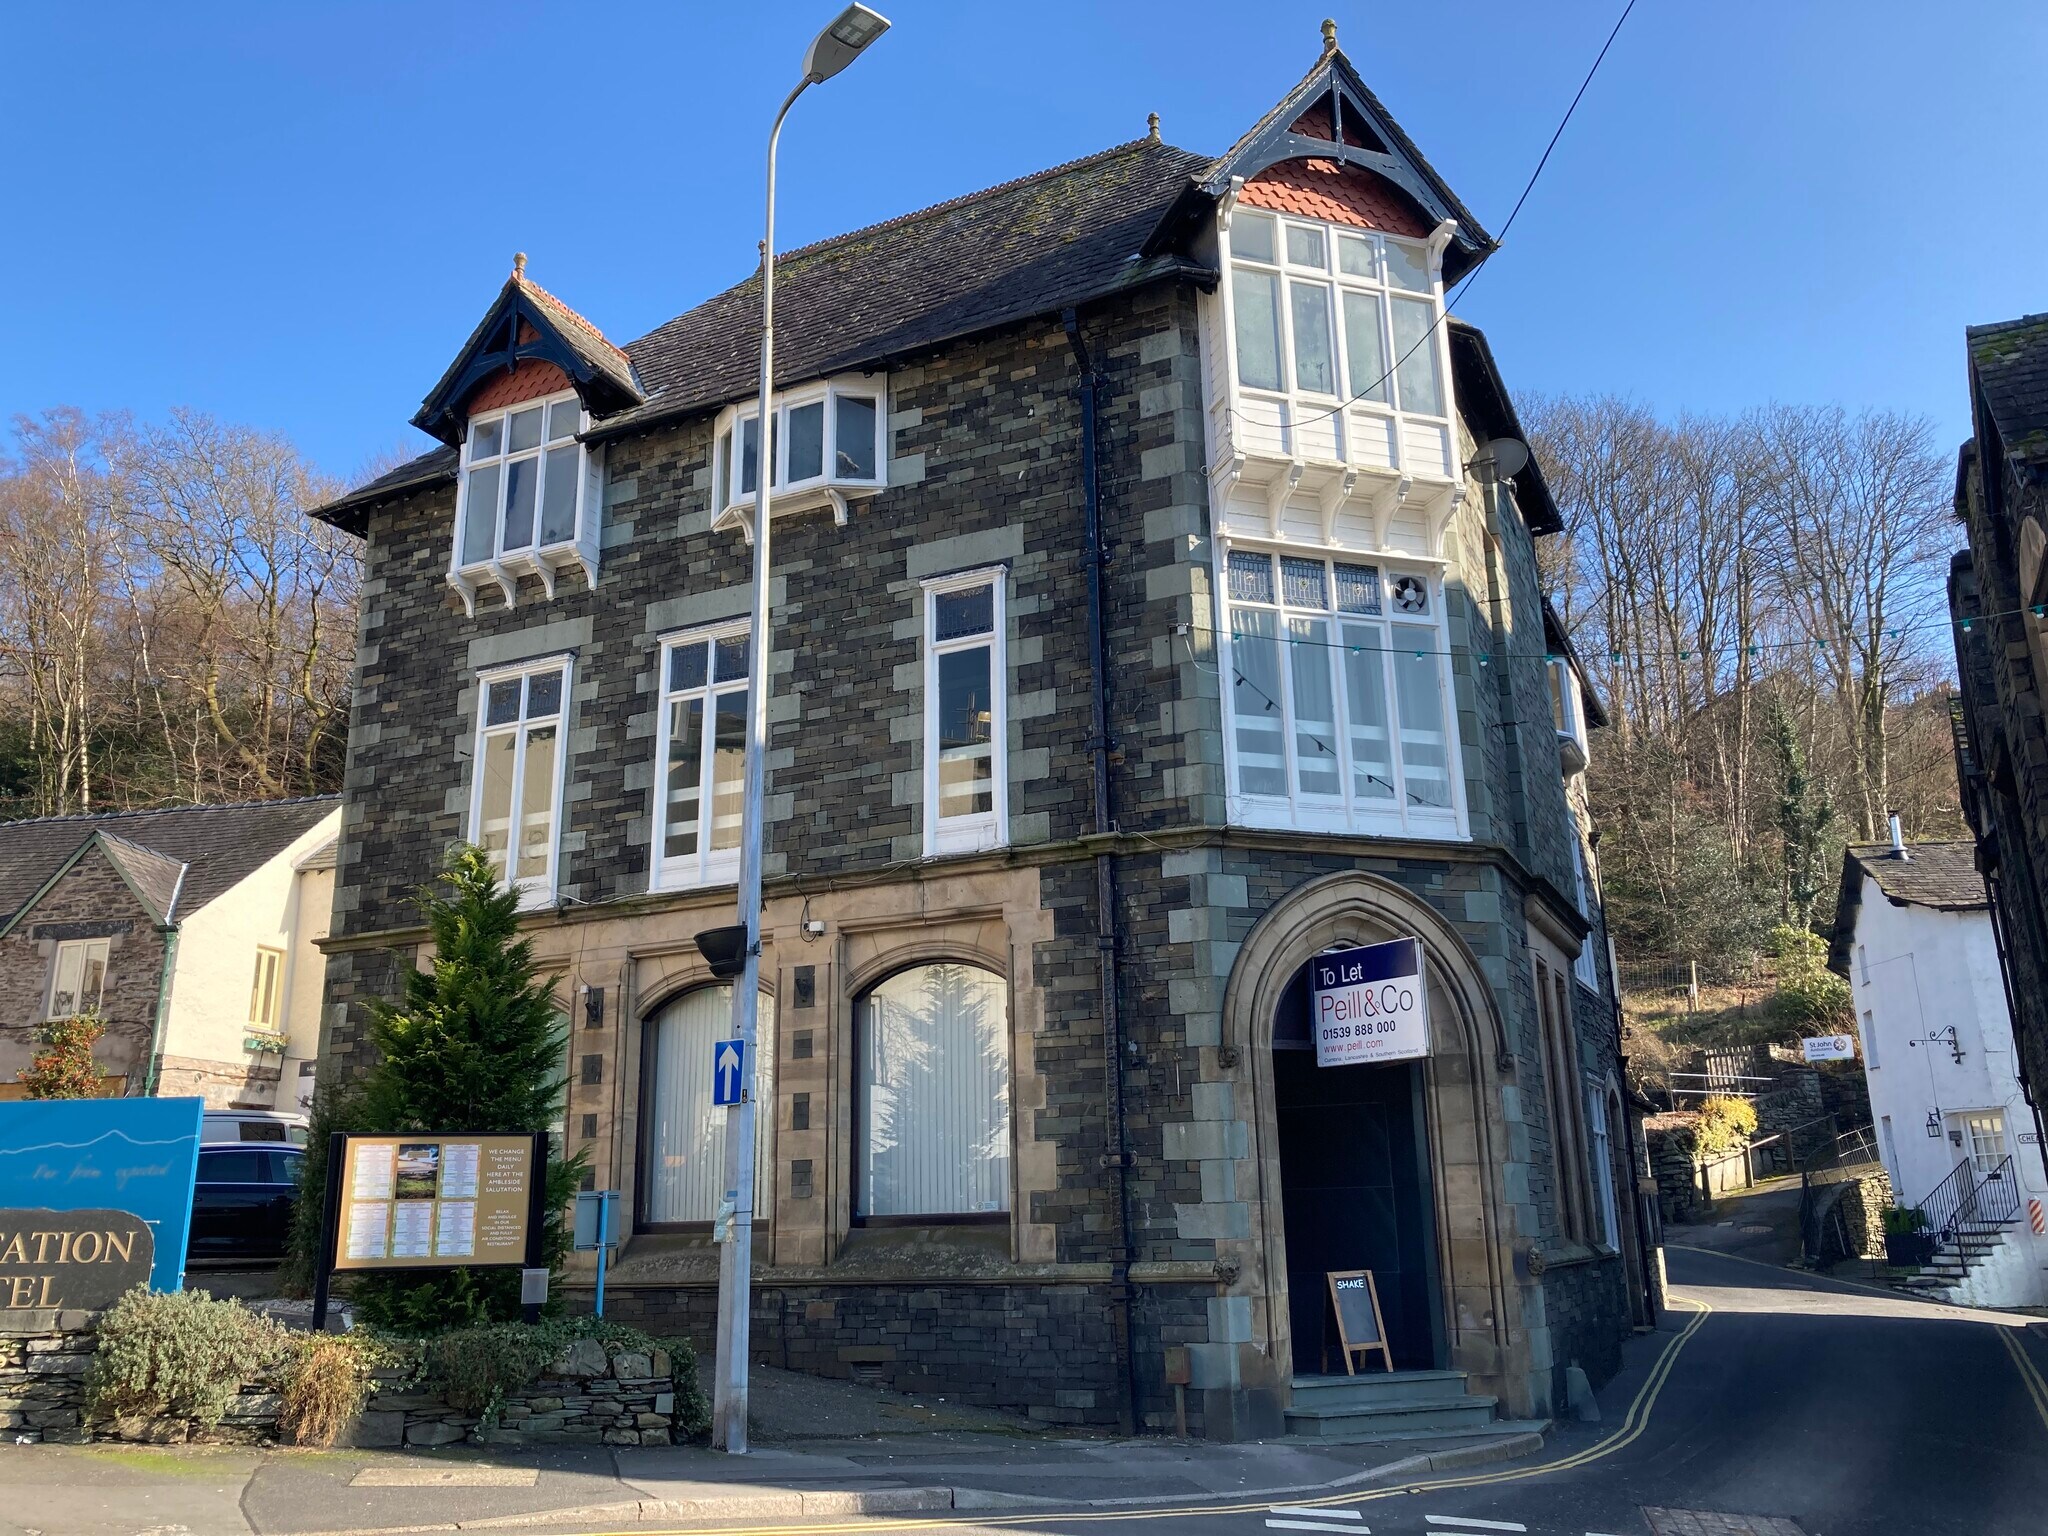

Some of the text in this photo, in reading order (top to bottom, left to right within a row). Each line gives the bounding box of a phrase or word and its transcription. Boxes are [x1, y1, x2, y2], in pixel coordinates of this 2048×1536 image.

[1320, 962, 1363, 986] To Let
[1321, 985, 1414, 1022] Peill&Co
[1322, 1020, 1396, 1040] 01539 888 000
[1323, 1038, 1384, 1053] www.peill.com
[1398, 1047, 1419, 1055] Scotland
[1337, 1279, 1364, 1289] SHAKE
